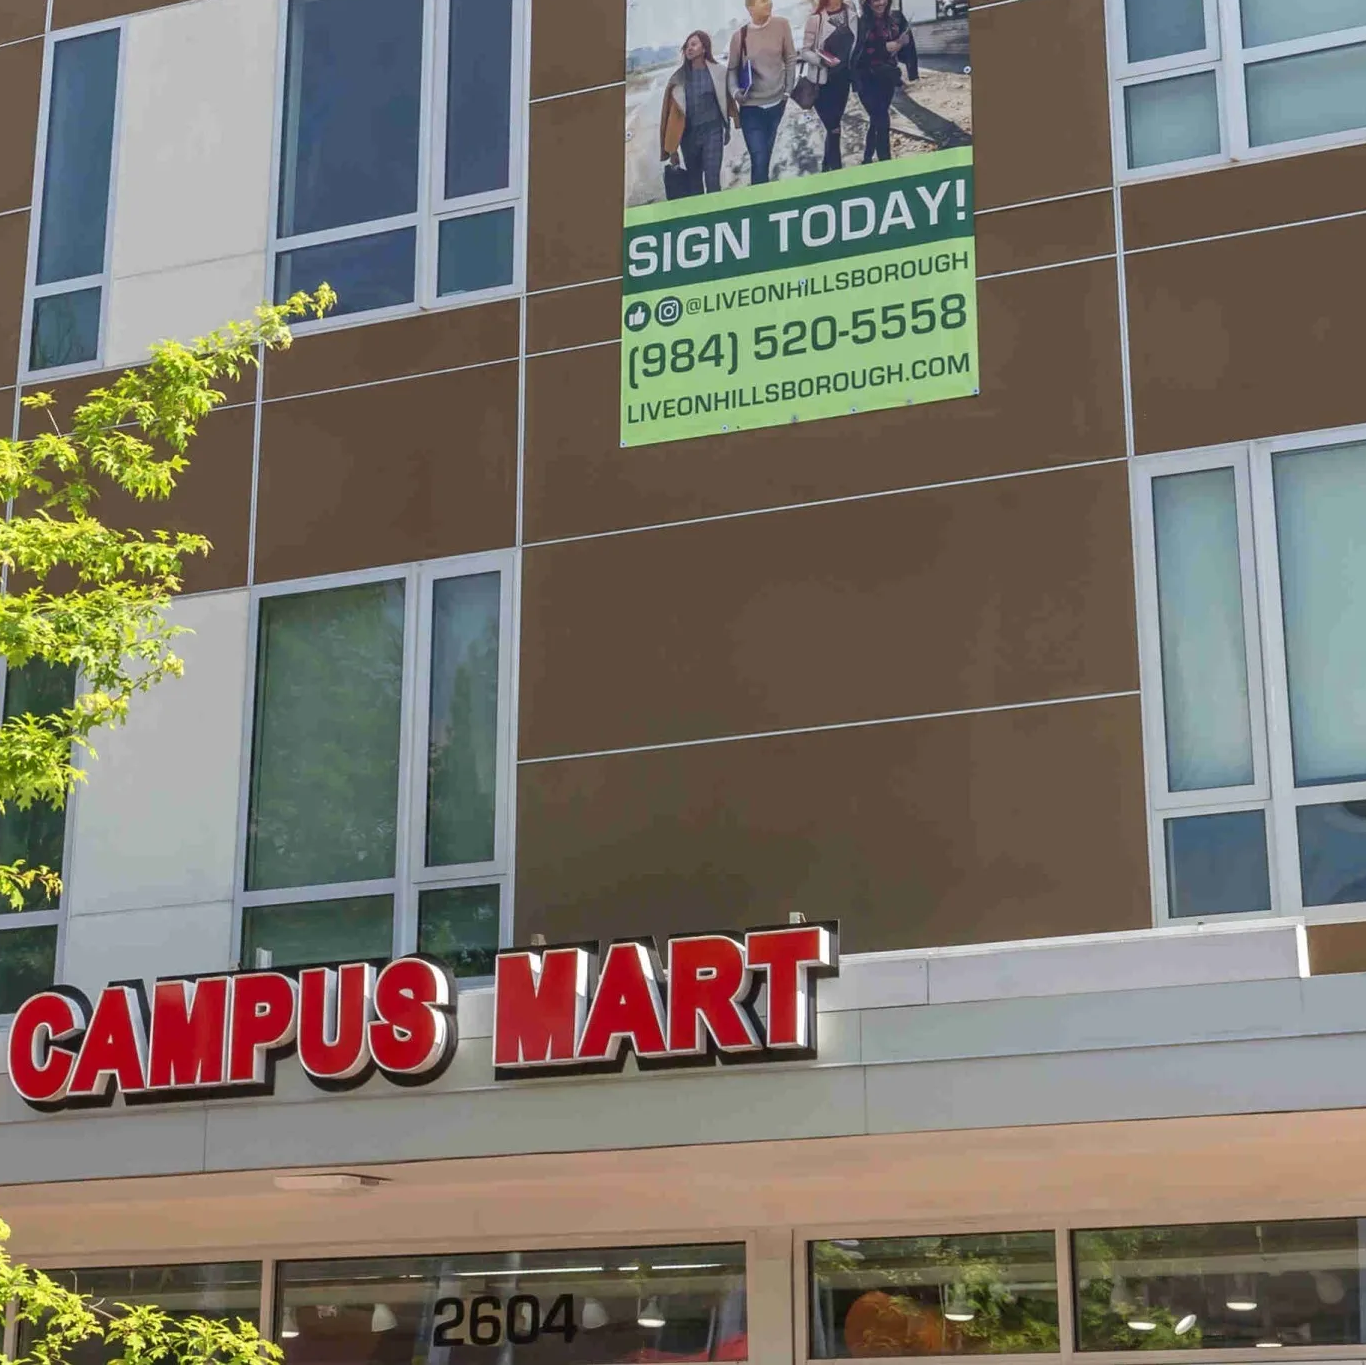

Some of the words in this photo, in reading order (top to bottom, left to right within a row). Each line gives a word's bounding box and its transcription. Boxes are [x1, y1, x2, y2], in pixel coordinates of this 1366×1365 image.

[628, 218, 750, 277] SIGN
[769, 179, 966, 252] TODAY!
[686, 251, 968, 315] @LIVEONHILLSBOROUGH
[629, 332, 738, 389] (984)
[754, 293, 966, 360] 520-5558
[627, 353, 970, 424] LIVEONHILLSBOROUGH.COM
[8, 955, 457, 1101] CAMPUS
[492, 923, 833, 1068] MART
[433, 1293, 577, 1347] 2604
